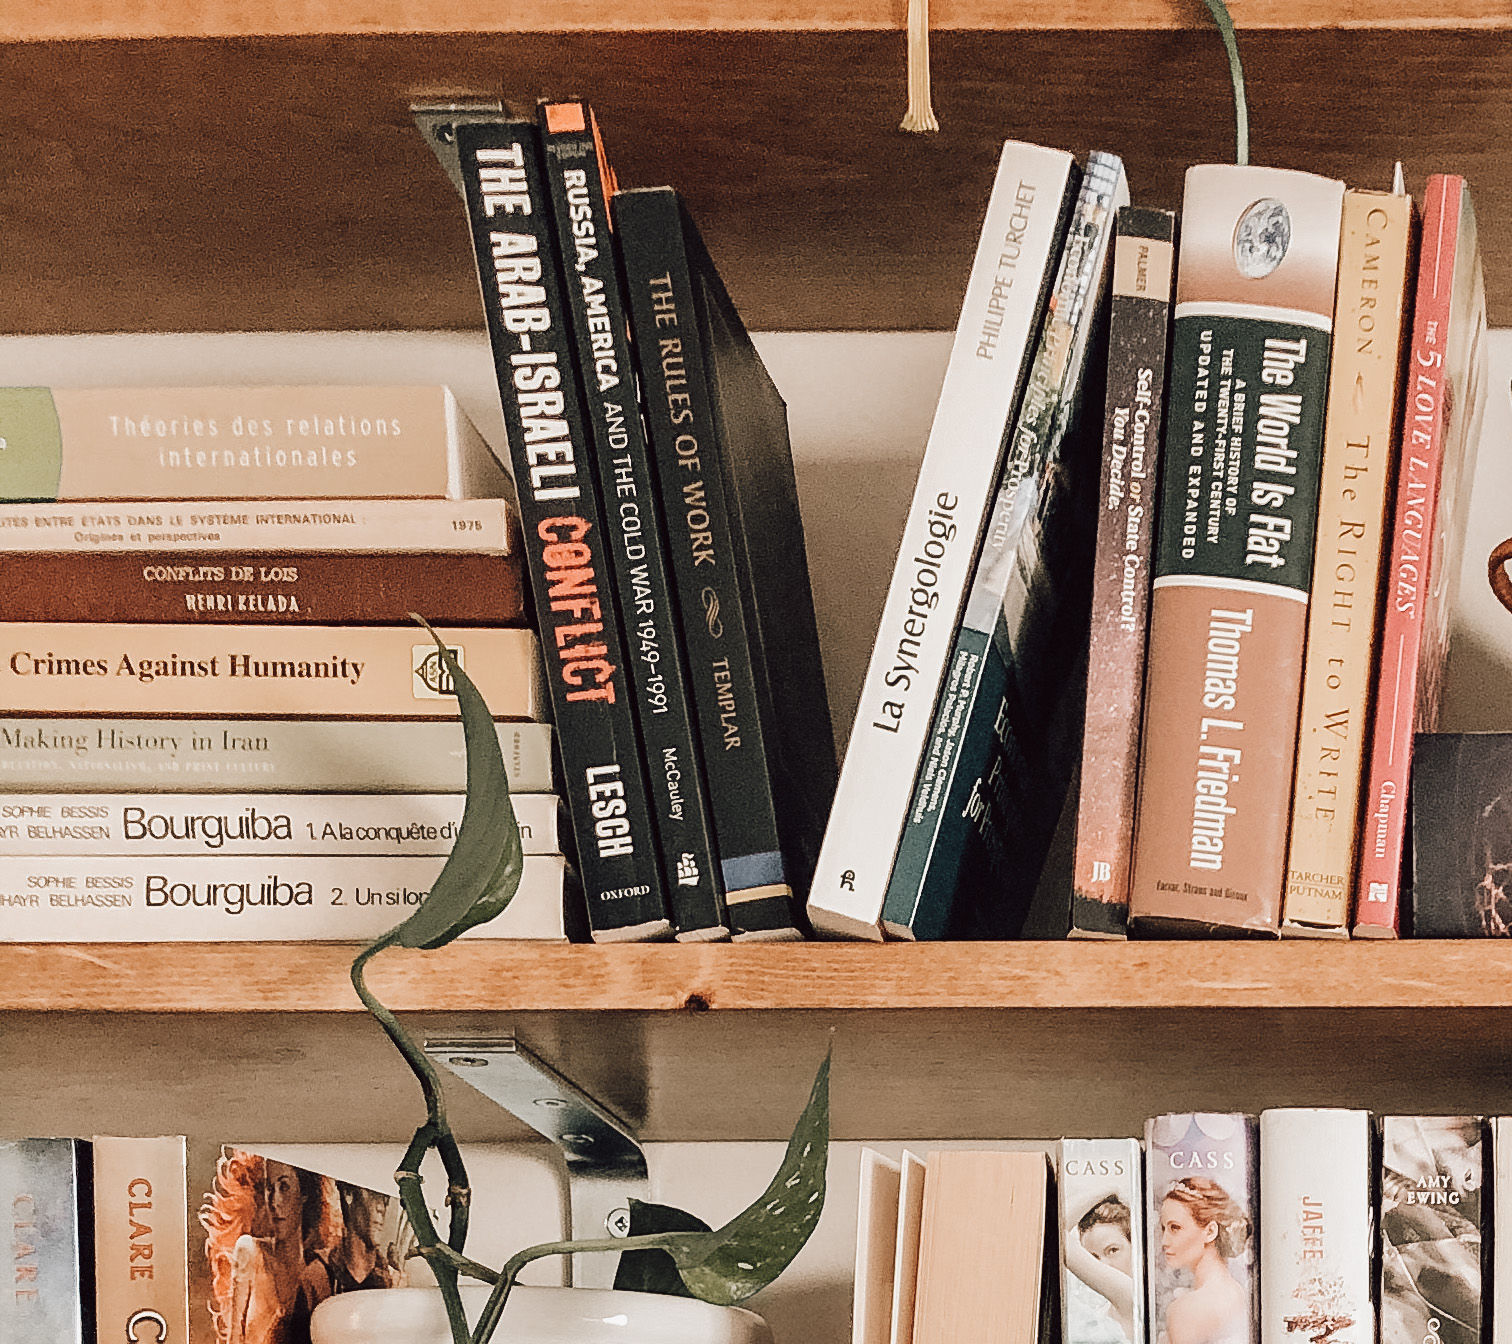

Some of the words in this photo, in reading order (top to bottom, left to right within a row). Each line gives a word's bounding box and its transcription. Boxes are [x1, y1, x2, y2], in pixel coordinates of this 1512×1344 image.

[476, 142, 532, 218] THE
[563, 169, 598, 271] RUSSIA,
[649, 271, 678, 329] THE
[581, 276, 619, 392] AMERICA
[1262, 338, 1307, 386] The
[1417, 351, 1442, 370] 5
[1425, 321, 1439, 345] THE
[490, 232, 580, 502] ARAB-ISRAELI
[659, 338, 693, 425] RULES
[109, 415, 218, 438] Théories
[233, 416, 273, 437] des
[286, 415, 402, 437] relations
[604, 402, 628, 449] AND
[1254, 395, 1303, 478] World
[1411, 375, 1437, 450] LOVE
[158, 446, 357, 467] internationales
[611, 453, 636, 496] THE
[675, 434, 699, 471] OF
[1342, 436, 1370, 503] The
[1251, 482, 1295, 507] Is
[620, 503, 645, 563] COLD
[682, 482, 716, 566] WORK
[1245, 510, 1292, 568] Flat
[1395, 458, 1432, 618] LANGUAGES
[538, 515, 616, 705] CONFLICT
[629, 566, 655, 614] WAR
[873, 699, 904, 734] La
[894, 490, 958, 693] Synergologie
[9, 651, 108, 677] Crimes
[116, 654, 219, 684] Against
[228, 654, 365, 685] Humanity
[1203, 608, 1254, 711] Thomas
[1327, 659, 1344, 690] to
[711, 656, 742, 751] TEMPLAR
[1200, 717, 1243, 741] L.
[586, 764, 634, 858] LESCH
[662, 747, 684, 821] McCauley
[1190, 744, 1242, 870] Friedman
[124, 808, 292, 848] Bourguiba
[1374, 780, 1396, 859] Chapman
[146, 875, 312, 915] Bourguiba
[600, 885, 650, 901] OXFORD
[1289, 870, 1344, 885] TARCHER
[1289, 884, 1343, 901] PUTNAM
[1065, 1160, 1124, 1176] CASS
[1169, 1152, 1235, 1169] CASS
[1416, 1175, 1451, 1188] AMY
[1301, 1195, 1324, 1260] JAFFE
[1406, 1191, 1460, 1206] EWING
[127, 1178, 153, 1281] CLARE
